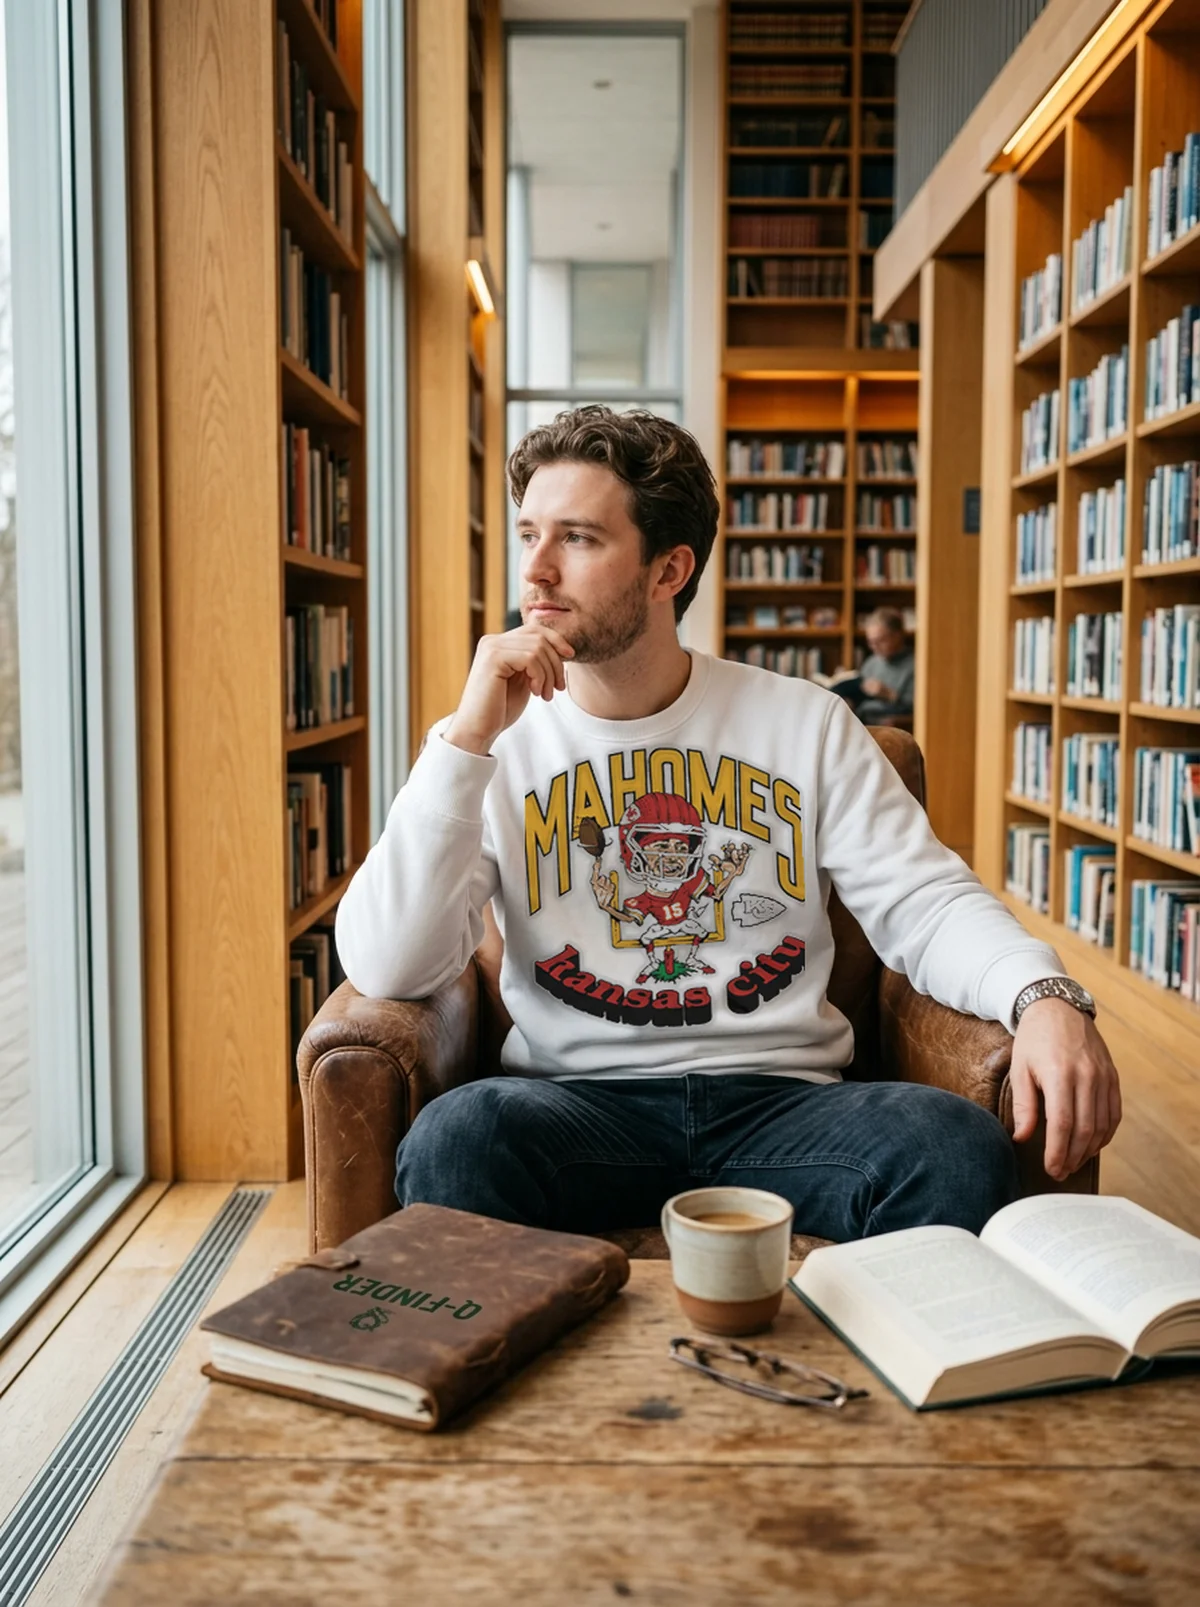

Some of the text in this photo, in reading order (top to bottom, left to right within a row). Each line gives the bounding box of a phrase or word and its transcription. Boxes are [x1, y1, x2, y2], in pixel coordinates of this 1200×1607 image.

[524, 747, 806, 916] MAHOMES
[662, 902, 683, 920] 15
[333, 1274, 483, 1320] Q-FINDER
